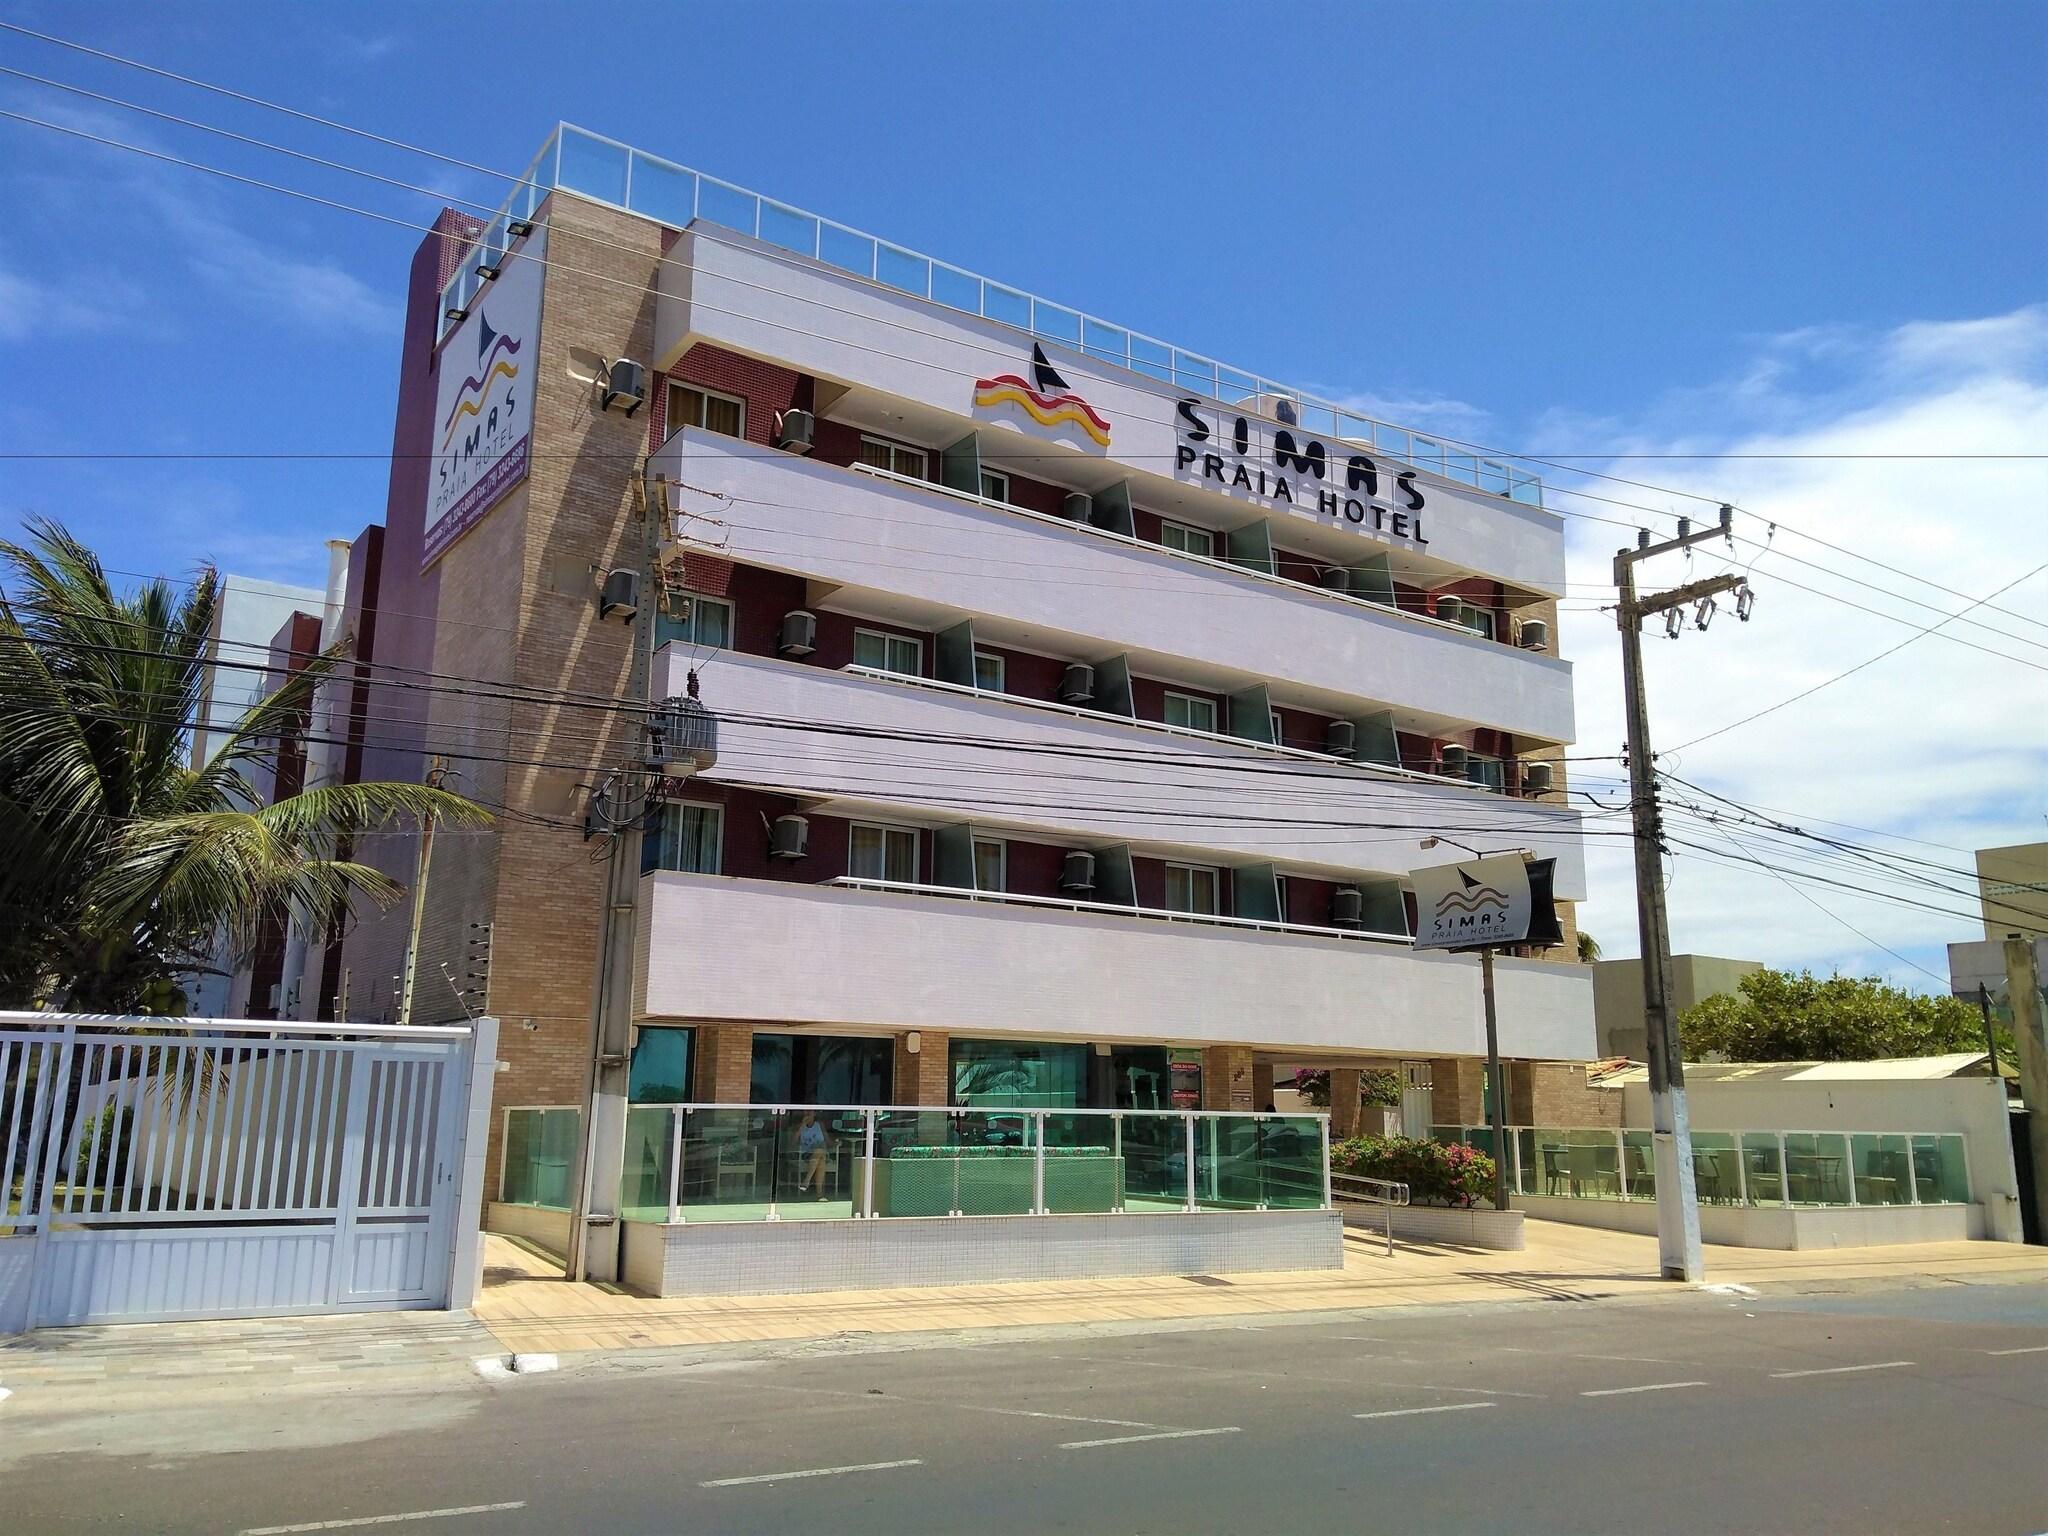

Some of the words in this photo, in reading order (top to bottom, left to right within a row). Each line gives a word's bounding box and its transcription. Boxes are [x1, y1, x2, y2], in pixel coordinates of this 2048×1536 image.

[436, 471, 467, 513] PRAIA
[475, 423, 514, 474] HOTEL
[440, 386, 515, 487] SIMAS
[1177, 398, 1425, 510] SIMAS
[1177, 445, 1293, 503] PRAIA
[1319, 489, 1429, 544] HOTEL
[1431, 930, 1463, 940] PRAIA
[1470, 924, 1506, 934] HOTEL
[1434, 911, 1507, 931] SIMAS
